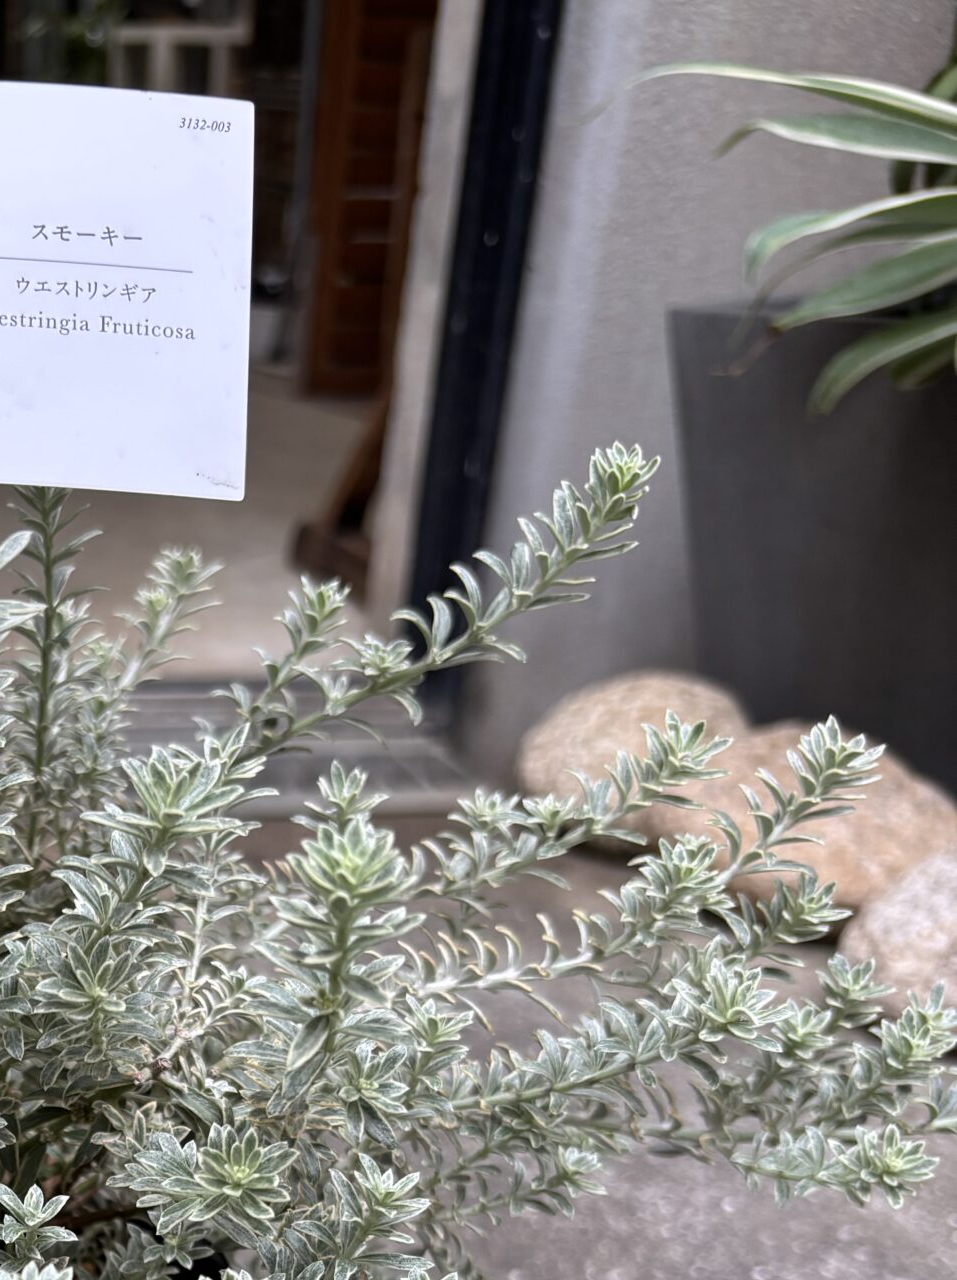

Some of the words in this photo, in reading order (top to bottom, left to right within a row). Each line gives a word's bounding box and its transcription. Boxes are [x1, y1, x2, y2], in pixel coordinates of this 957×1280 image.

[178, 117, 232, 133] 3132-003
[31, 224, 143, 246] スモーキー
[15, 277, 157, 303] ウエストリンギア
[99, 315, 196, 340] Fruticosa
